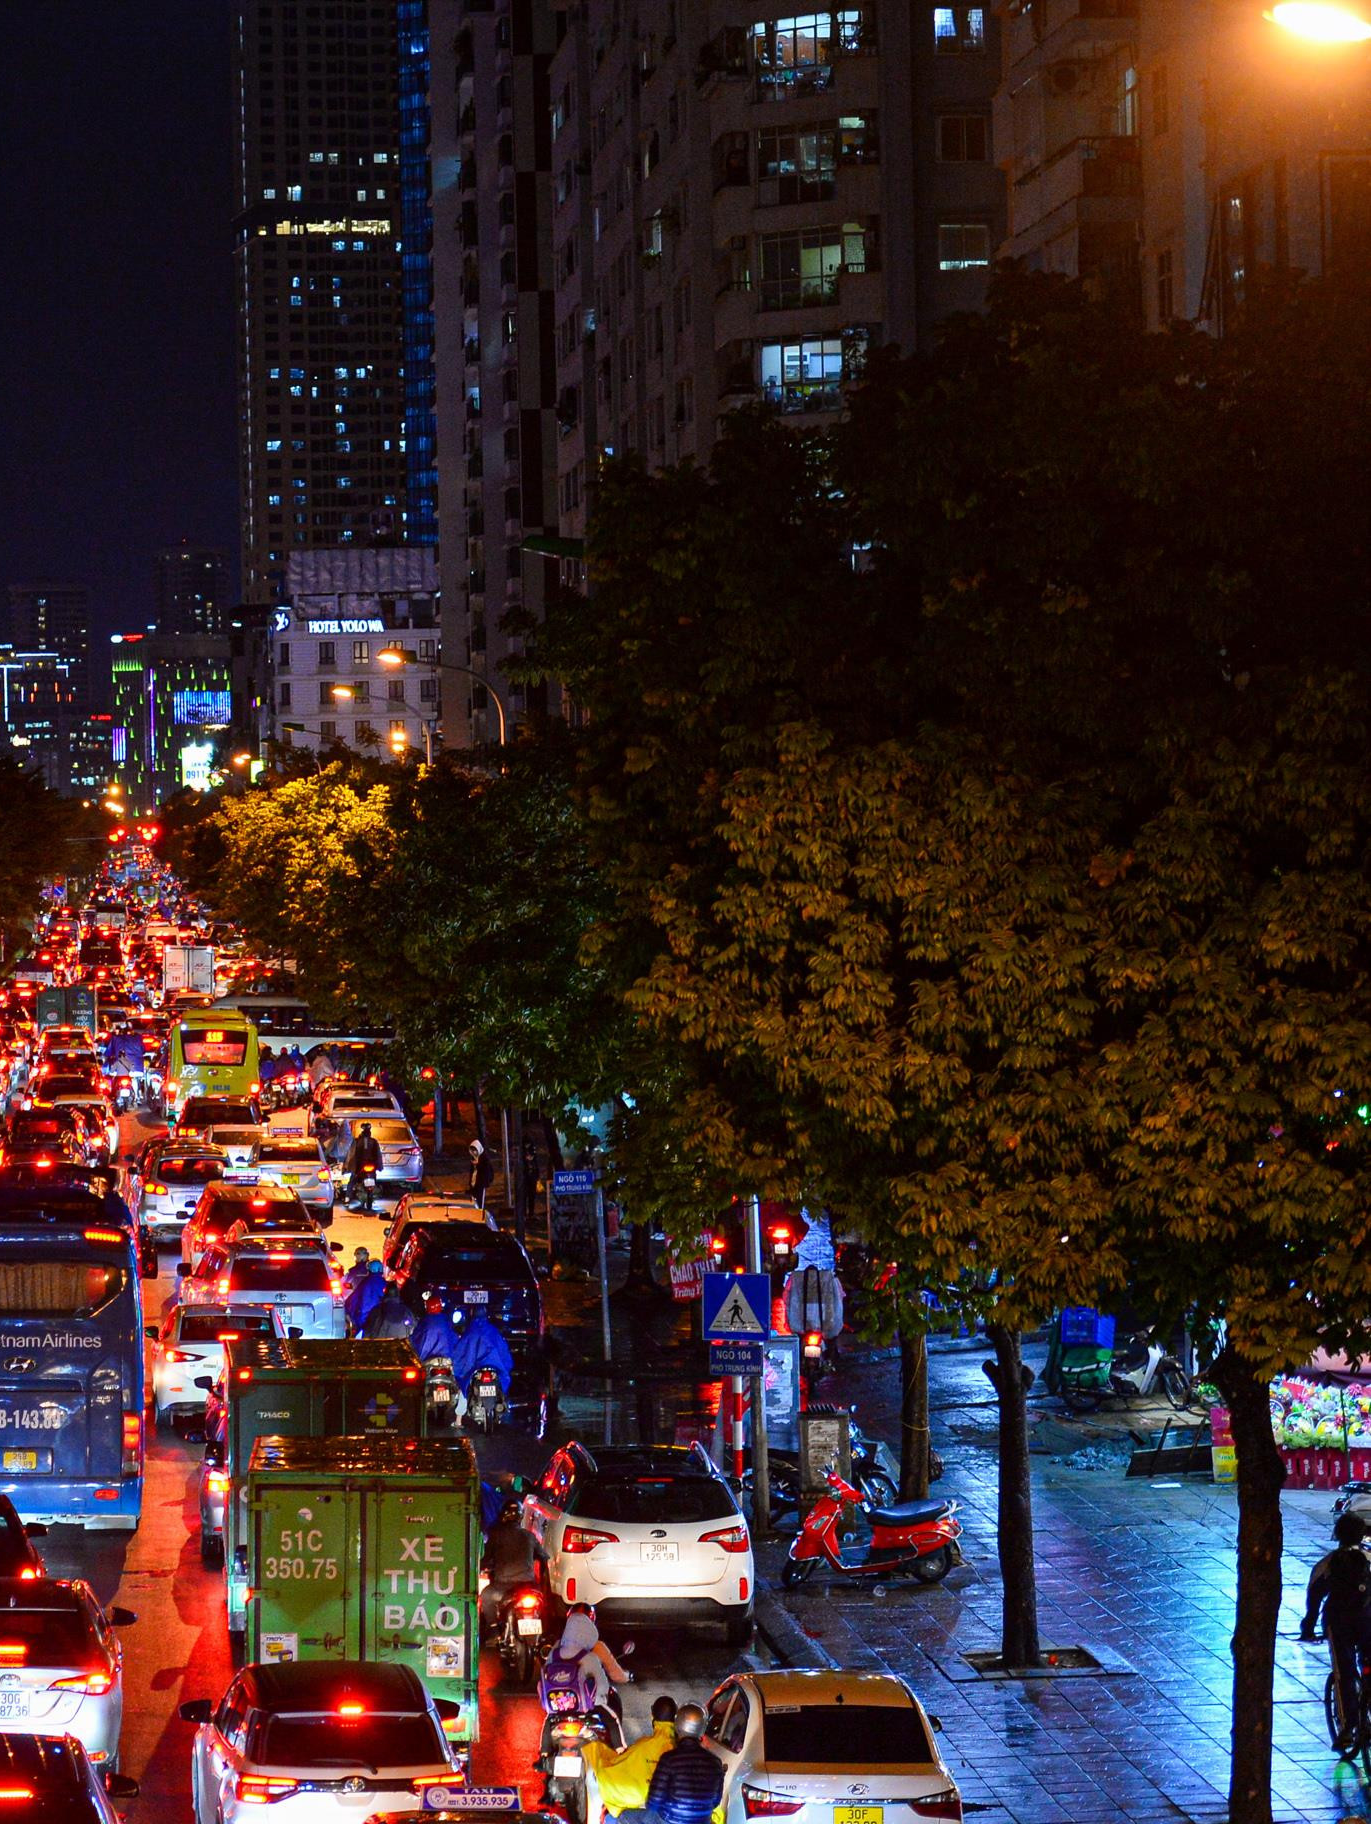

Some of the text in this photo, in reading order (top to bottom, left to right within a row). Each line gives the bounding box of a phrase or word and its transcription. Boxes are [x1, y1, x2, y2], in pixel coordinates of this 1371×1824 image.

[309, 620, 341, 634] HOTEL
[342, 619, 368, 633] YOLO
[42, 1333, 102, 1348] Airlines
[737, 1350, 751, 1360] 104
[280, 1529, 323, 1551] 51C
[399, 1537, 444, 1562] XE
[265, 1556, 338, 1579] 350.75
[384, 1566, 458, 1595] THƯ
[384, 1598, 460, 1631] BÁO
[461, 1796, 509, 1806] 3.935.935
[847, 1809, 868, 1820] 30F
